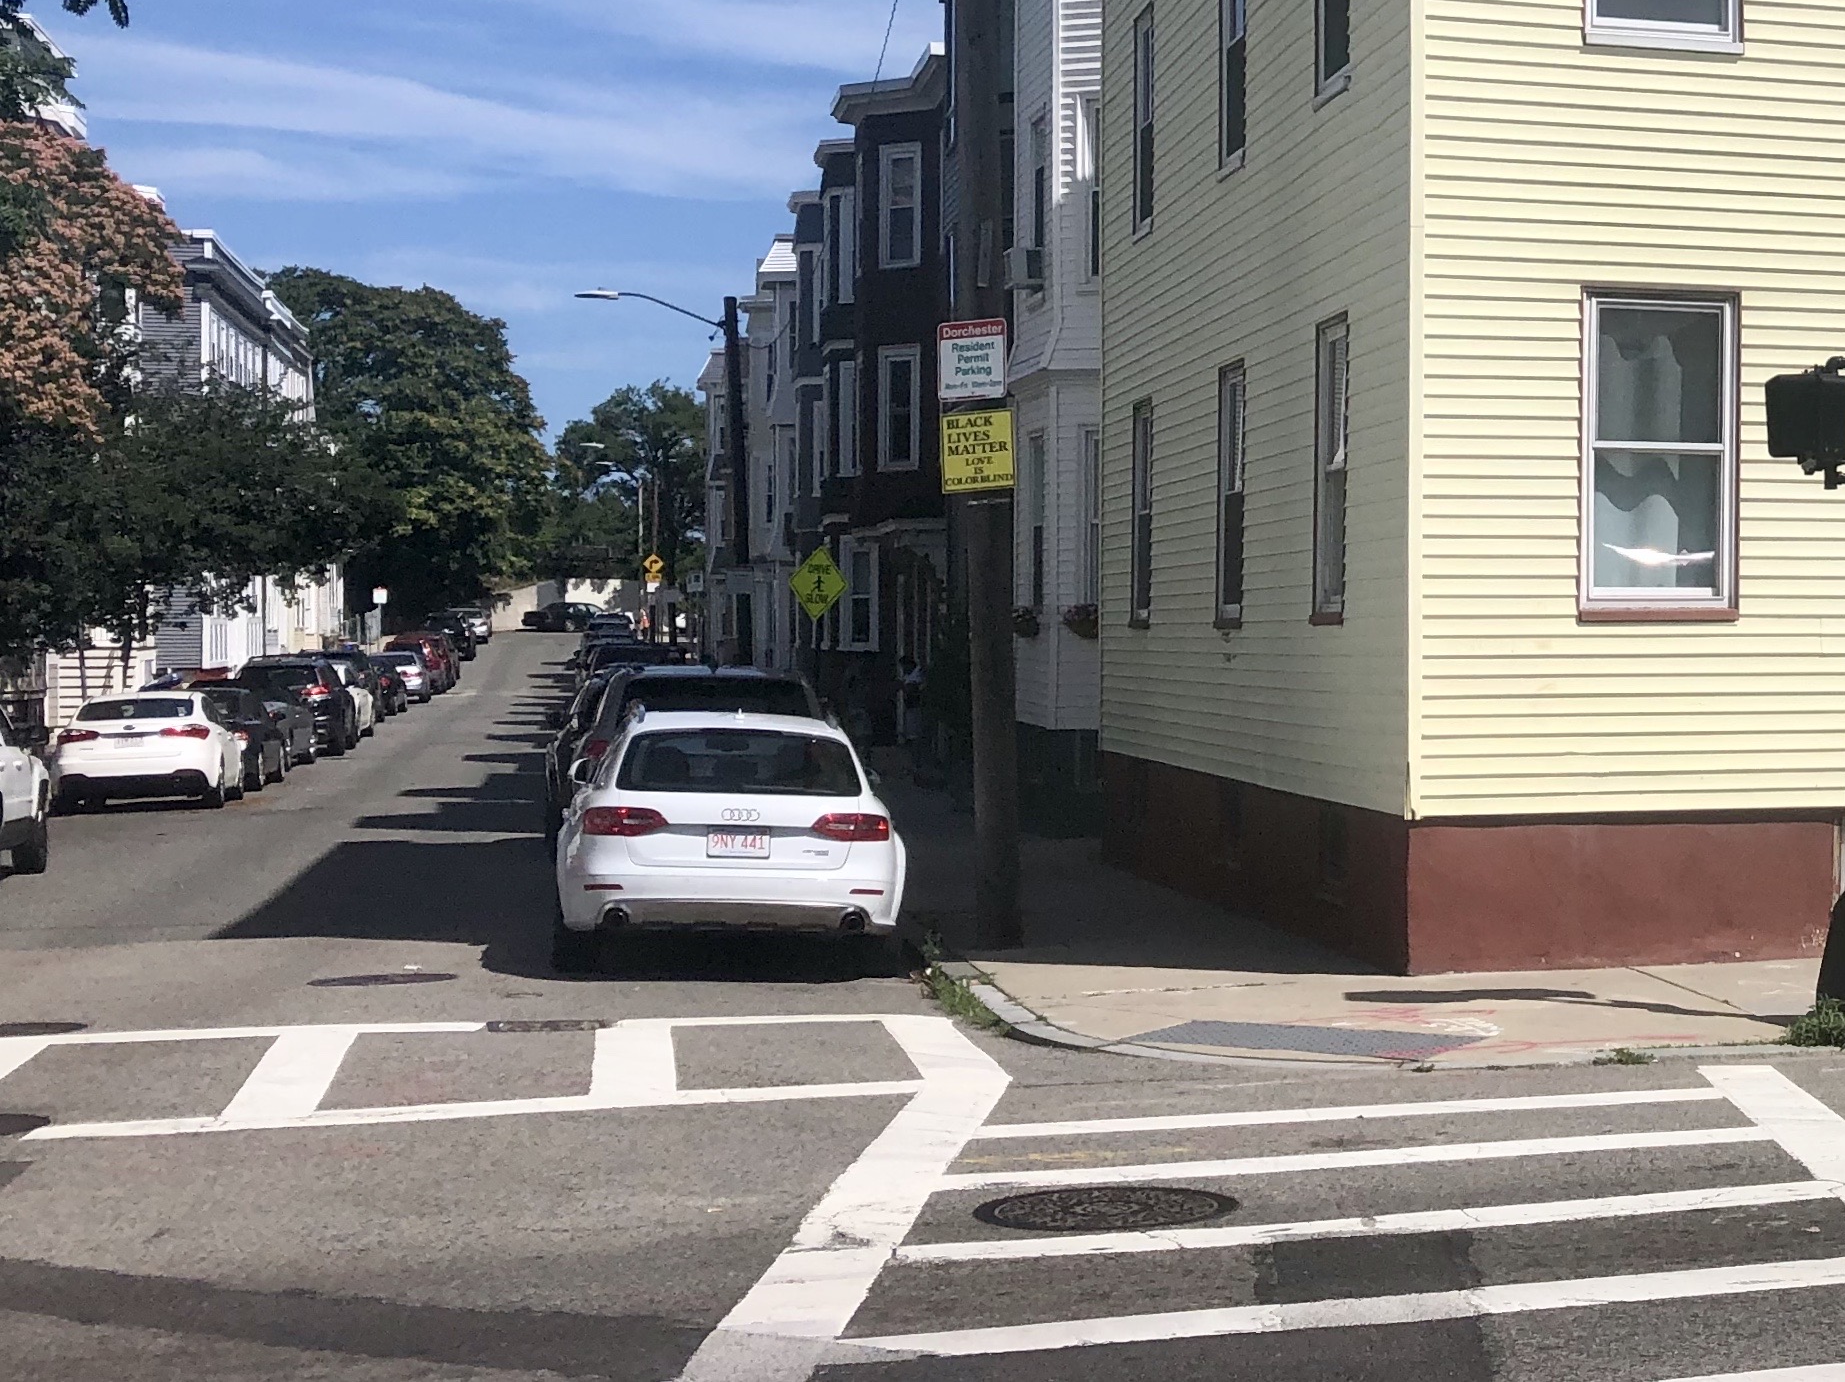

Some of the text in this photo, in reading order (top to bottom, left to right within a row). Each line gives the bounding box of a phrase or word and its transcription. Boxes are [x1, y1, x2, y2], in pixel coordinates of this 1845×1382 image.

[942, 324, 1003, 338] Dorchester
[951, 341, 995, 353] Resident
[957, 353, 990, 364] Permit
[954, 364, 992, 377] Parking
[946, 415, 993, 430] BLACK
[947, 430, 990, 443] LIVES
[947, 441, 1009, 457] MATTER
[965, 456, 993, 466] LOVE
[974, 466, 984, 474] IS
[807, 564, 832, 575] DRIVE
[805, 594, 829, 604] SLOW
[711, 834, 766, 850] 9NY 441
